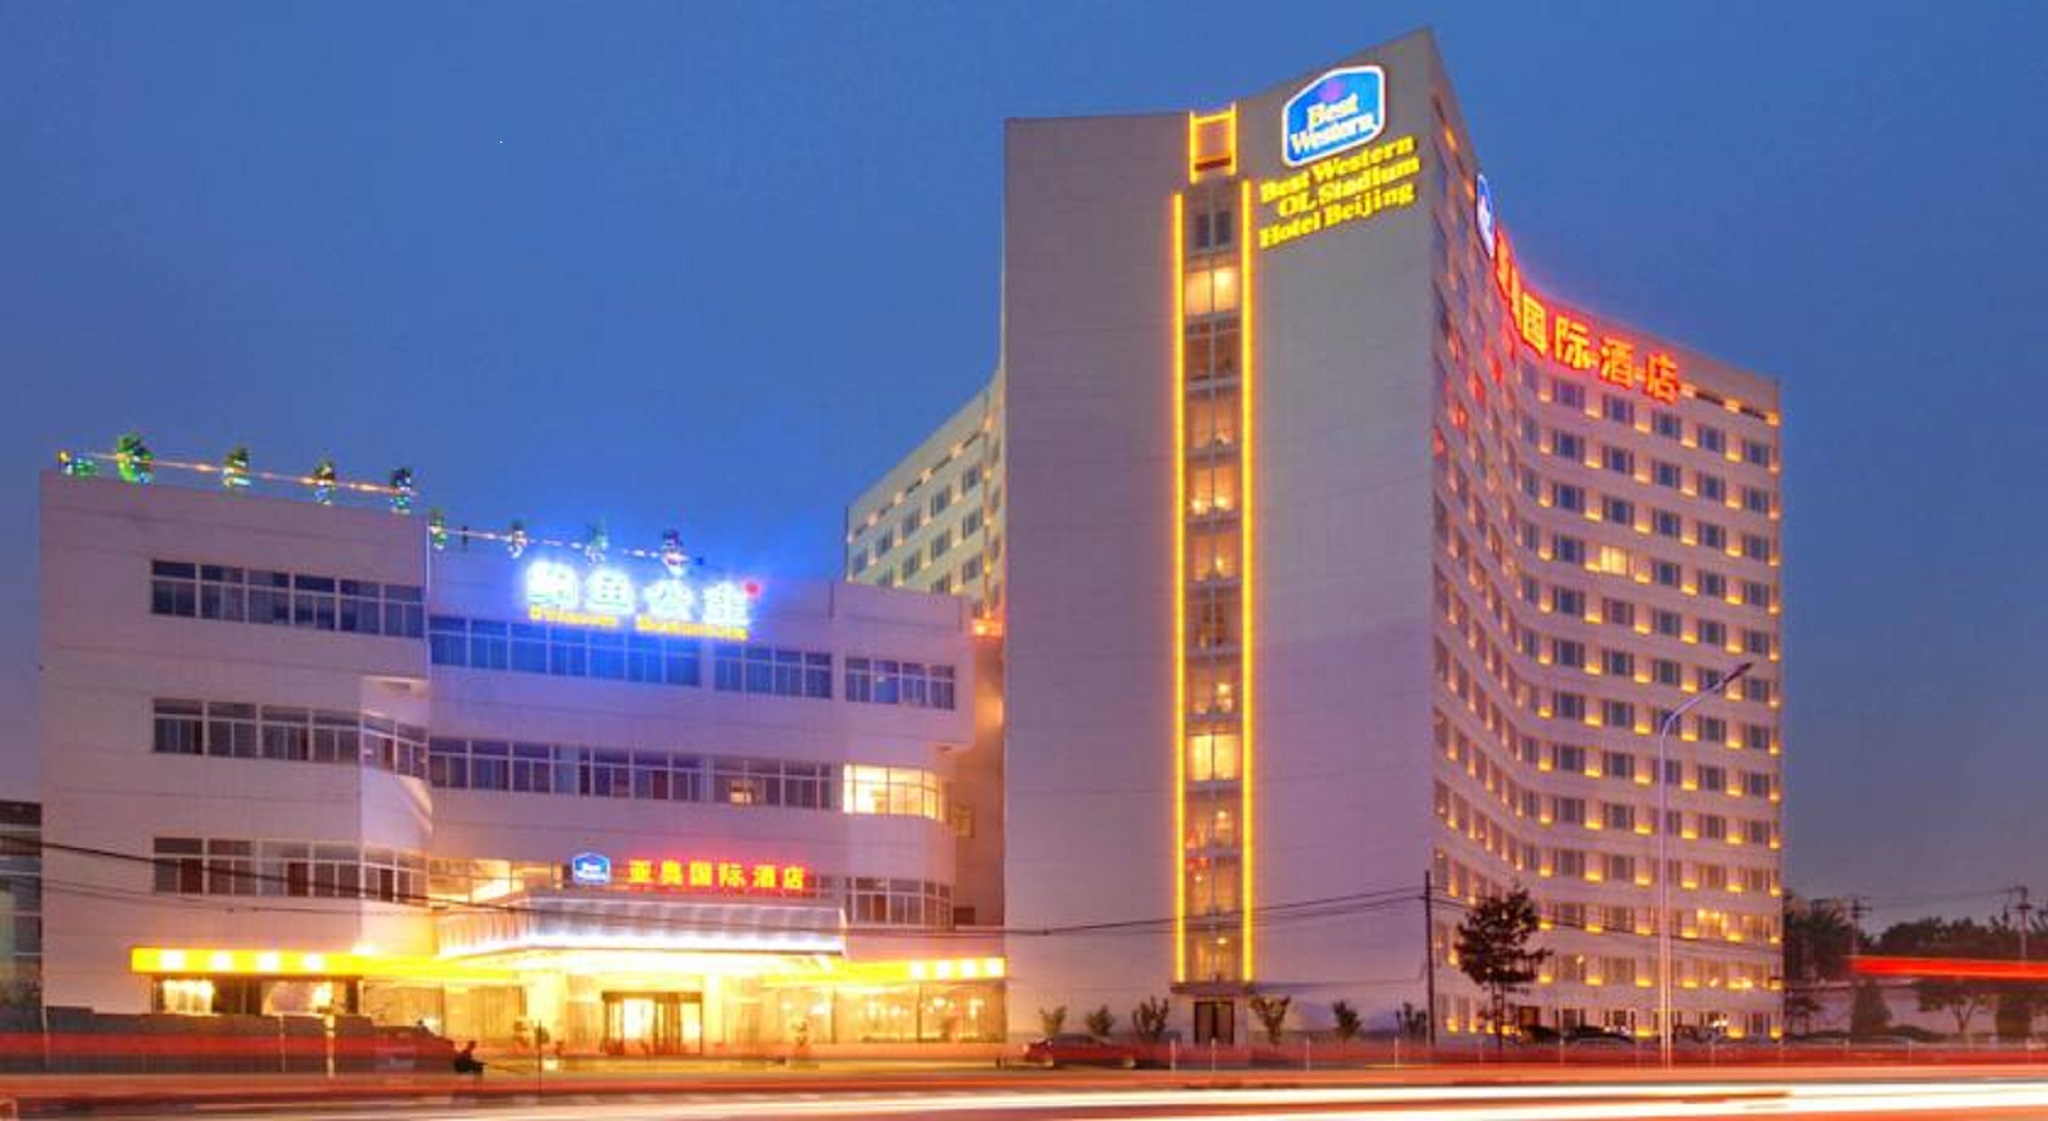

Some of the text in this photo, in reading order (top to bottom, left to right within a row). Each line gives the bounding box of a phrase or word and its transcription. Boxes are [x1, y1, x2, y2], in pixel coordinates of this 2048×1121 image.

[1290, 113, 1374, 154] Western
[1307, 92, 1358, 129] Best
[1259, 135, 1414, 203] Best Western
[1278, 156, 1420, 217] OL Stadium
[1258, 184, 1415, 249] Hotel Beijing
